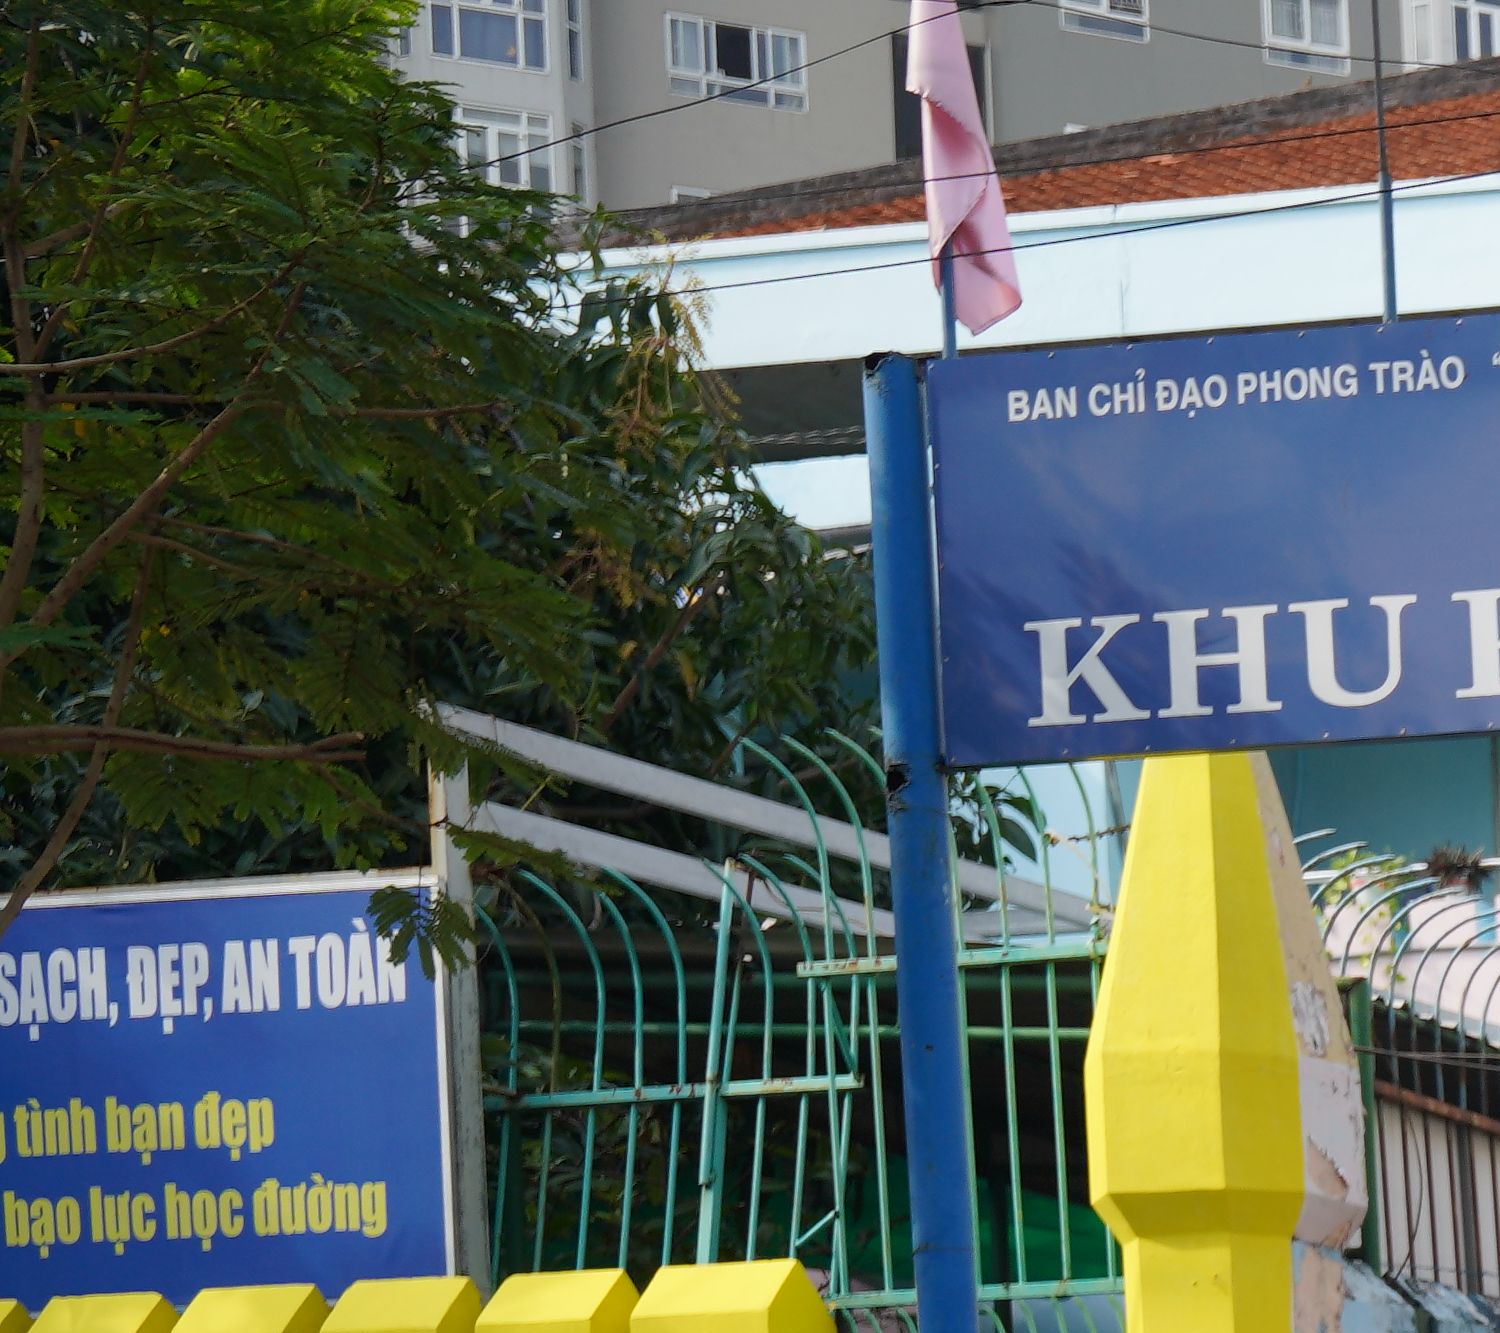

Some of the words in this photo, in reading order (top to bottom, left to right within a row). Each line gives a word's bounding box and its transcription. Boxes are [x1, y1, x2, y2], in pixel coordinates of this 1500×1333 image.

[1007, 388, 1076, 422] BAN
[1088, 367, 1146, 418] CHỈ
[1155, 376, 1227, 419] ĐẠO
[1237, 363, 1359, 403] PHONG
[1369, 353, 1464, 394] TRÀO
[1023, 595, 1417, 728] KHU
[126, 943, 213, 1034] ĐẸP,
[222, 938, 280, 1013] AN
[14, 1097, 96, 1157] tình
[105, 1096, 185, 1165] bạn
[194, 1091, 274, 1161] đẹp
[3, 1190, 81, 1259] bạo
[90, 1186, 156, 1255] lực
[165, 1183, 243, 1251] học
[253, 1173, 387, 1238] đường
